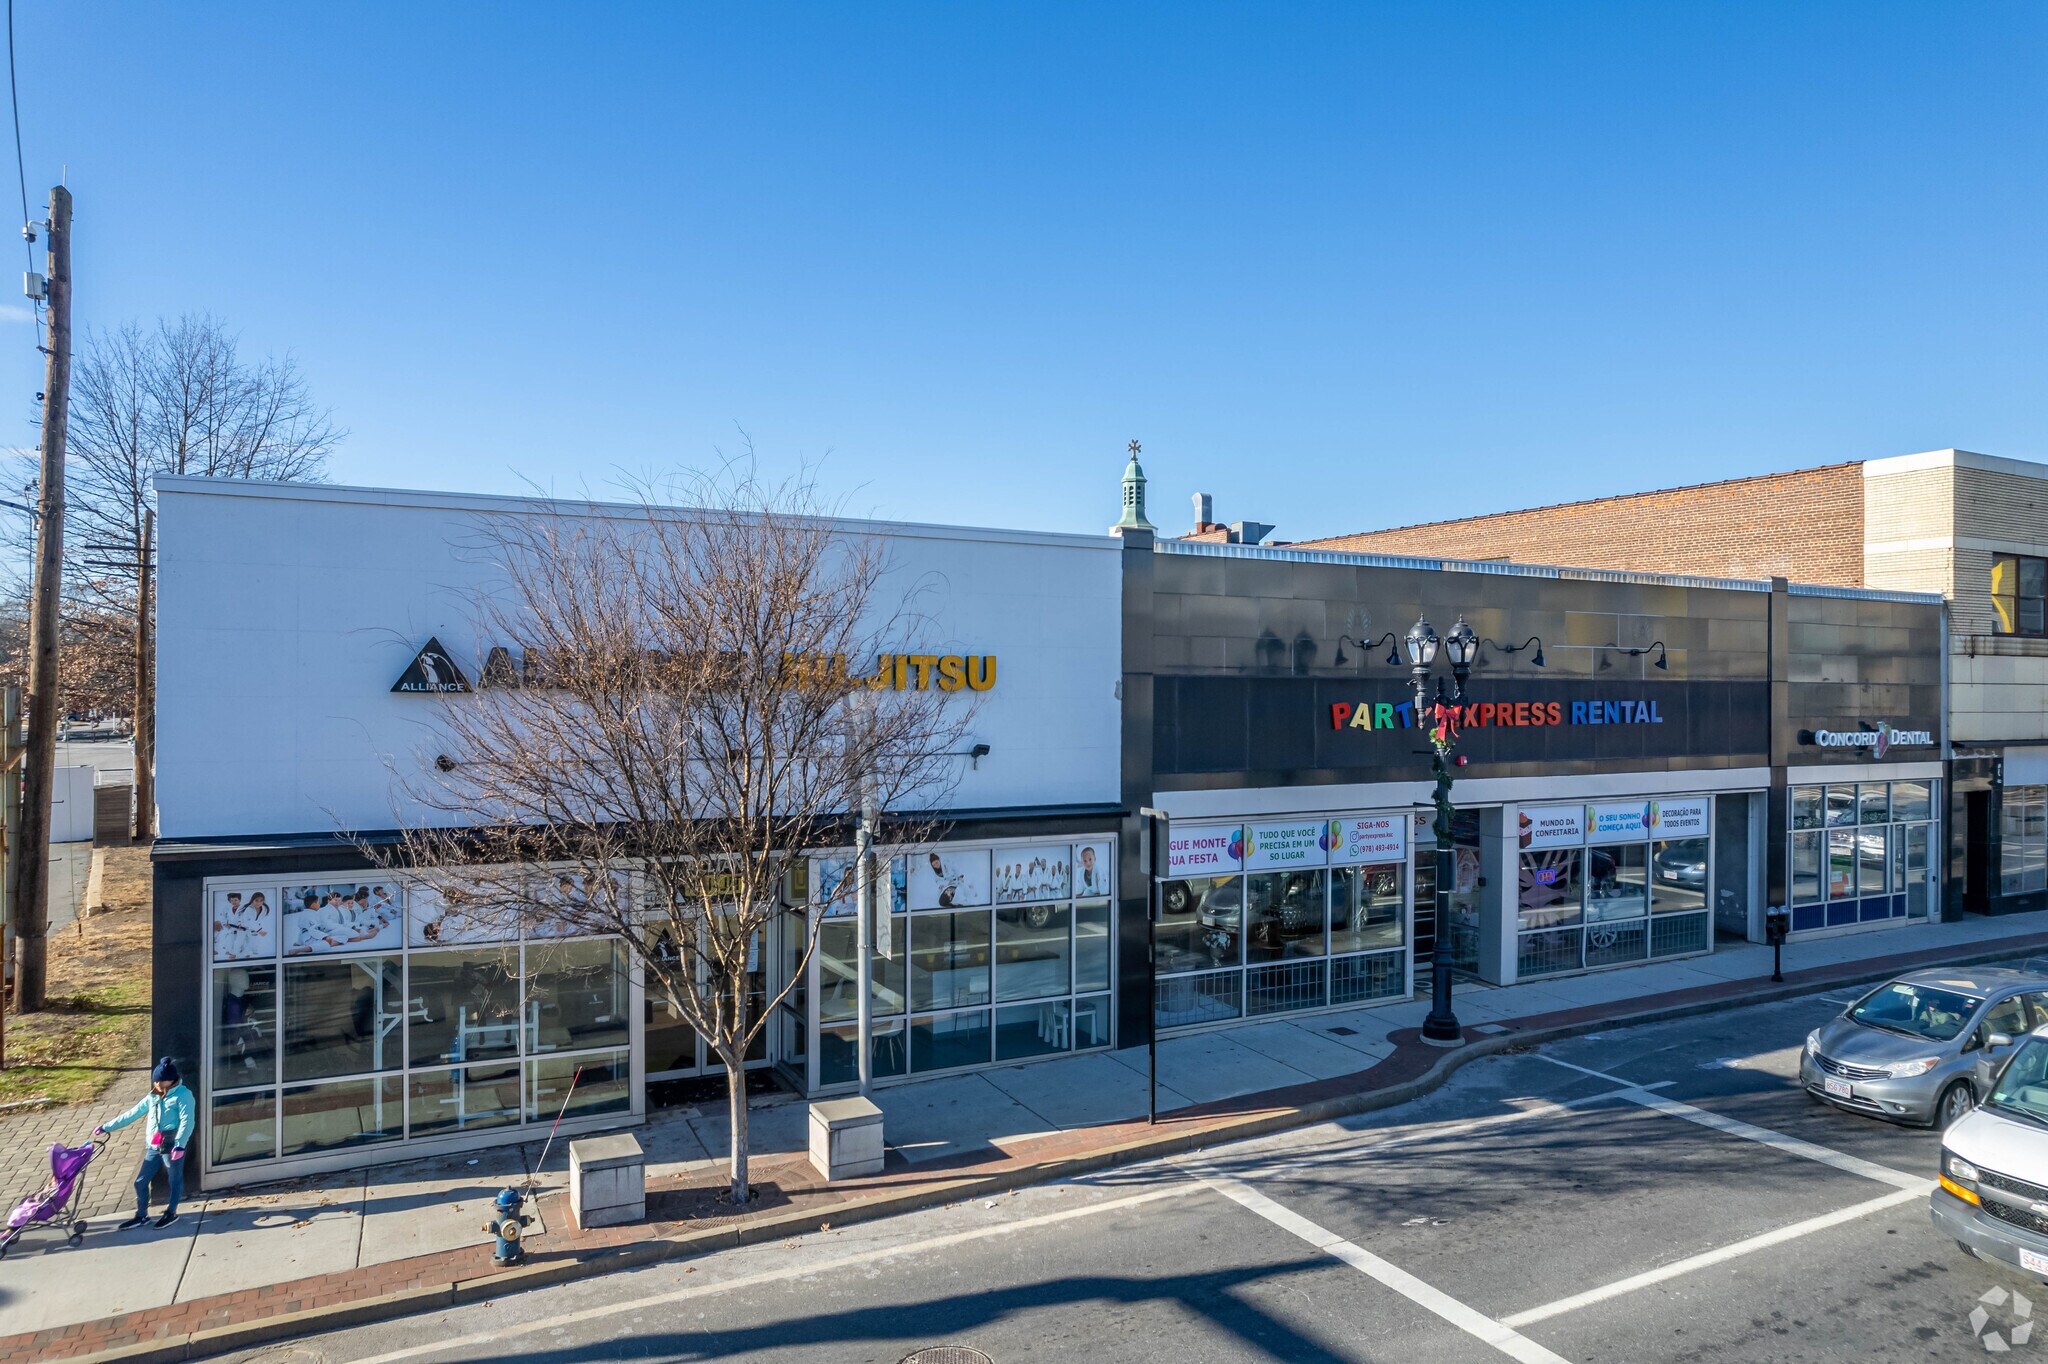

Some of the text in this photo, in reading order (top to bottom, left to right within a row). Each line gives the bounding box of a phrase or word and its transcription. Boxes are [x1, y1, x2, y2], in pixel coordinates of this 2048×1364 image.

[400, 682, 465, 692] ALLIANCE
[1450, 702, 1561, 728] XPRESS
[1570, 701, 1663, 725] RENTAL
[1818, 729, 1934, 747] CONCORD DENTAL
[1606, 814, 1618, 822] SEU
[1619, 812, 1641, 821] SONHO
[1662, 807, 1701, 818] DECORAÇÃO PARA
[1357, 820, 1390, 830] SIGA-NOS
[1540, 818, 1575, 827] MUNDO DA
[1598, 822, 1641, 833] COMEÇA AQUI
[1664, 818, 1700, 828] TODOS EVENTOS
[1259, 826, 1316, 839] TUDO QUE VOCÊ
[1535, 827, 1579, 838] CONFEITARIA
[1192, 838, 1227, 849] MONTE
[1259, 839, 1315, 850] PRECISA EM UM
[1269, 850, 1305, 860] SO LUGAR
[1360, 845, 1375, 855] (978)
[1188, 853, 1218, 865] FESTA
